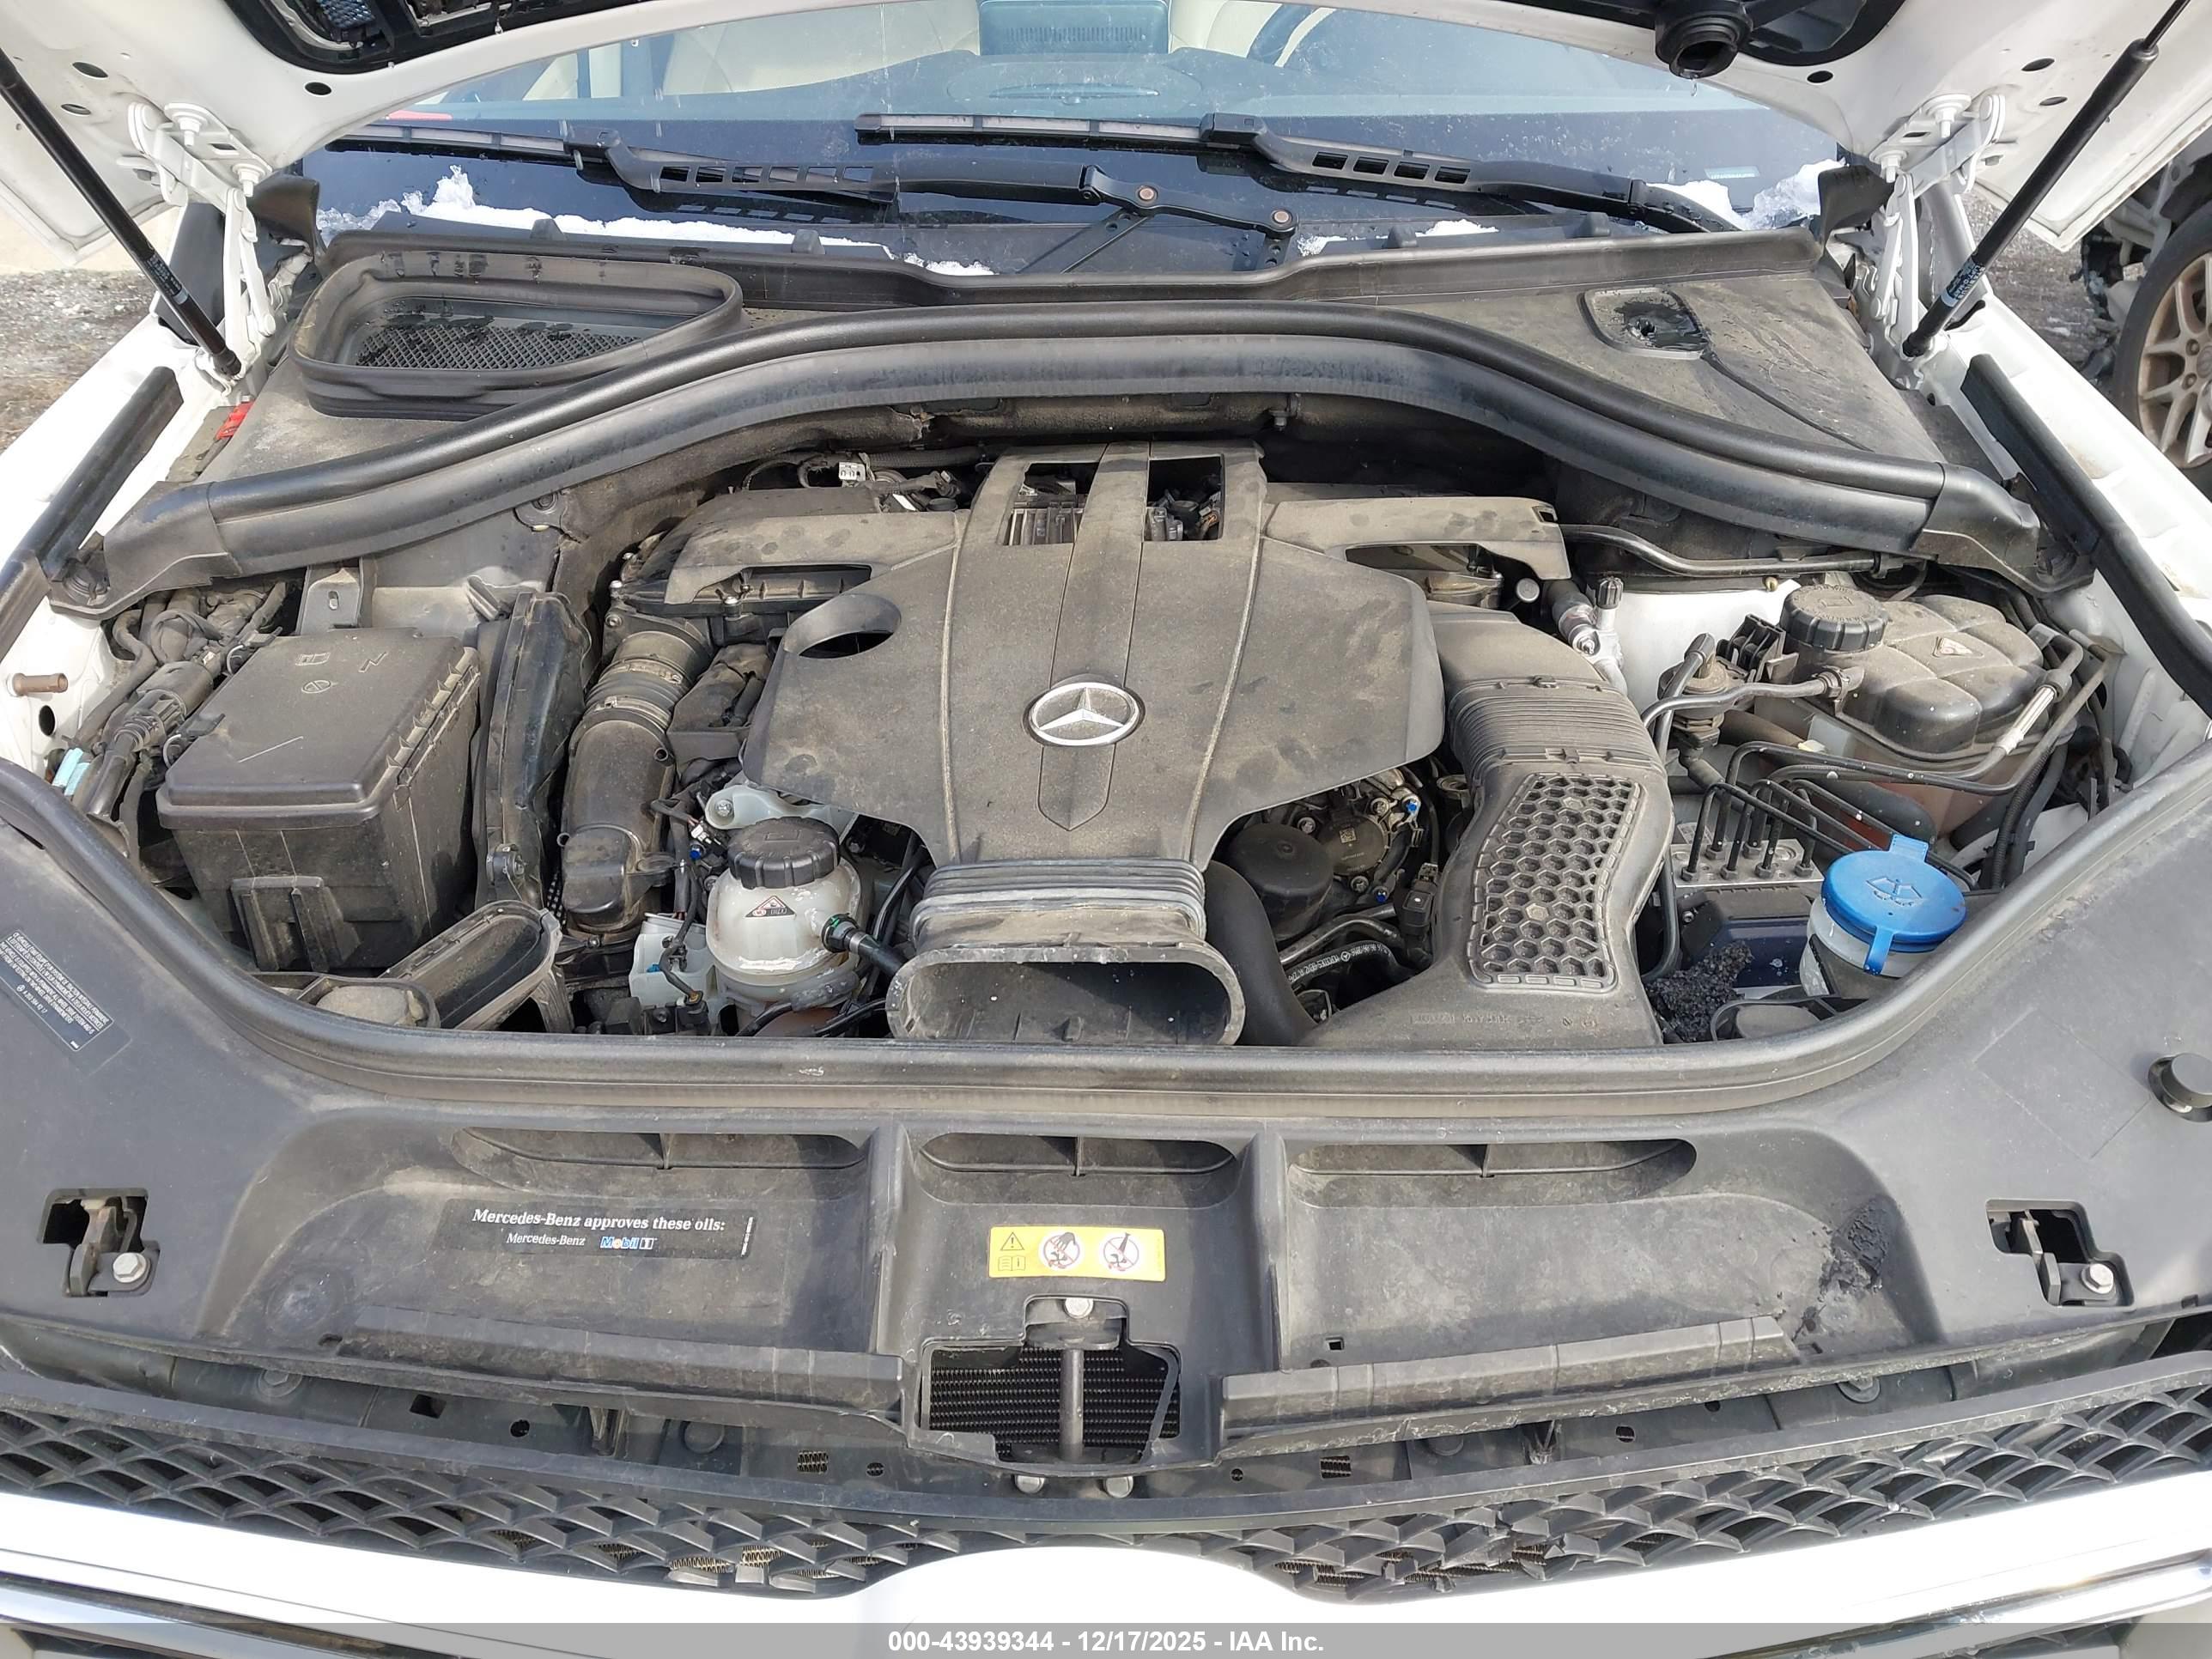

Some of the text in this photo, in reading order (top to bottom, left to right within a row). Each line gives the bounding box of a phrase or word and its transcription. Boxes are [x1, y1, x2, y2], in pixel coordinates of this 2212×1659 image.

[472, 1209, 726, 1231] Mercedes-Benz approves these oils:
[506, 1233, 586, 1246] Mercedes-Benz
[600, 1237, 640, 1249] Mobil
